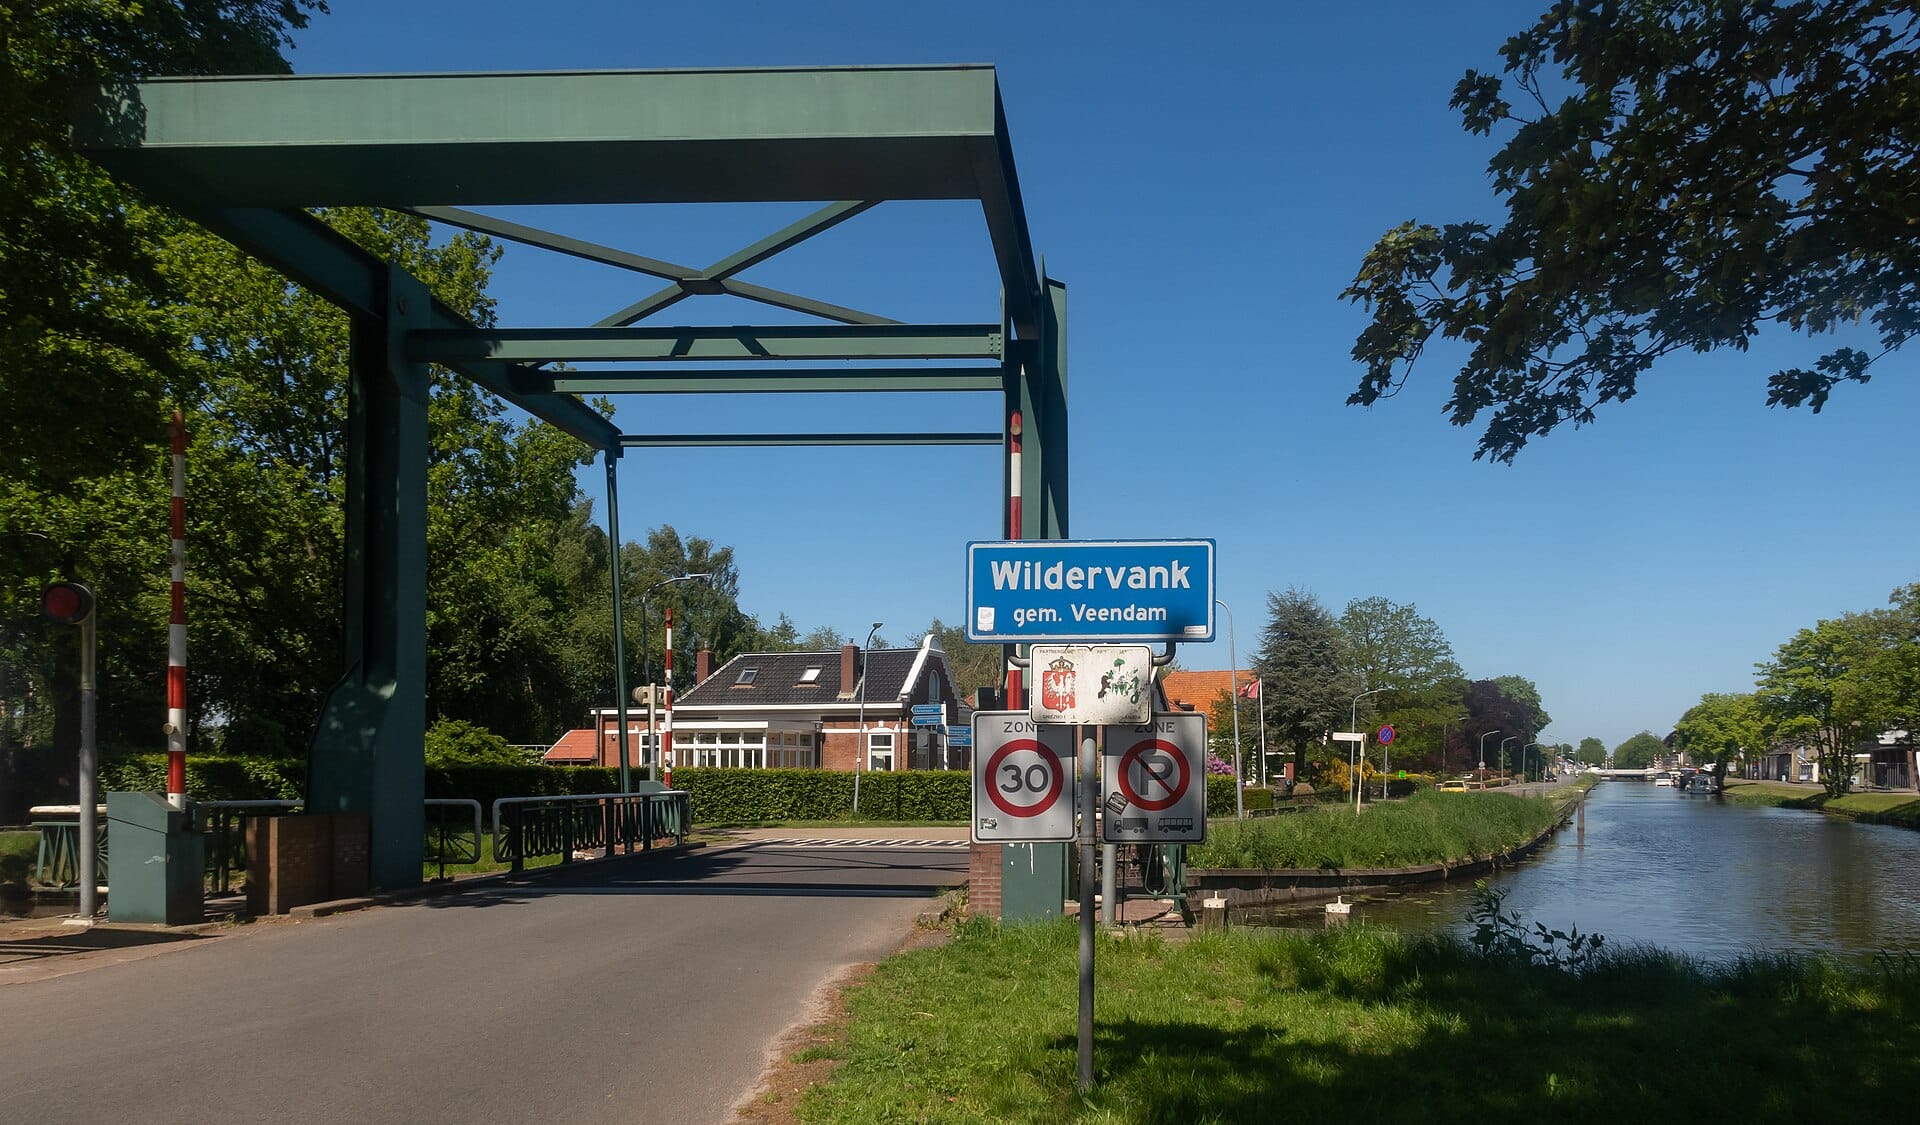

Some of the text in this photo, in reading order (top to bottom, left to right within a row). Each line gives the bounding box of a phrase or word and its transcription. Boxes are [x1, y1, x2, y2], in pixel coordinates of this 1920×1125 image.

[990, 559, 1191, 591] Wildervank
[1013, 606, 1063, 628] gem.
[1070, 603, 1168, 622] Veendam
[1003, 721, 1045, 733] ZONE
[1134, 721, 1176, 733] ZONE
[1000, 763, 1049, 793] 30
